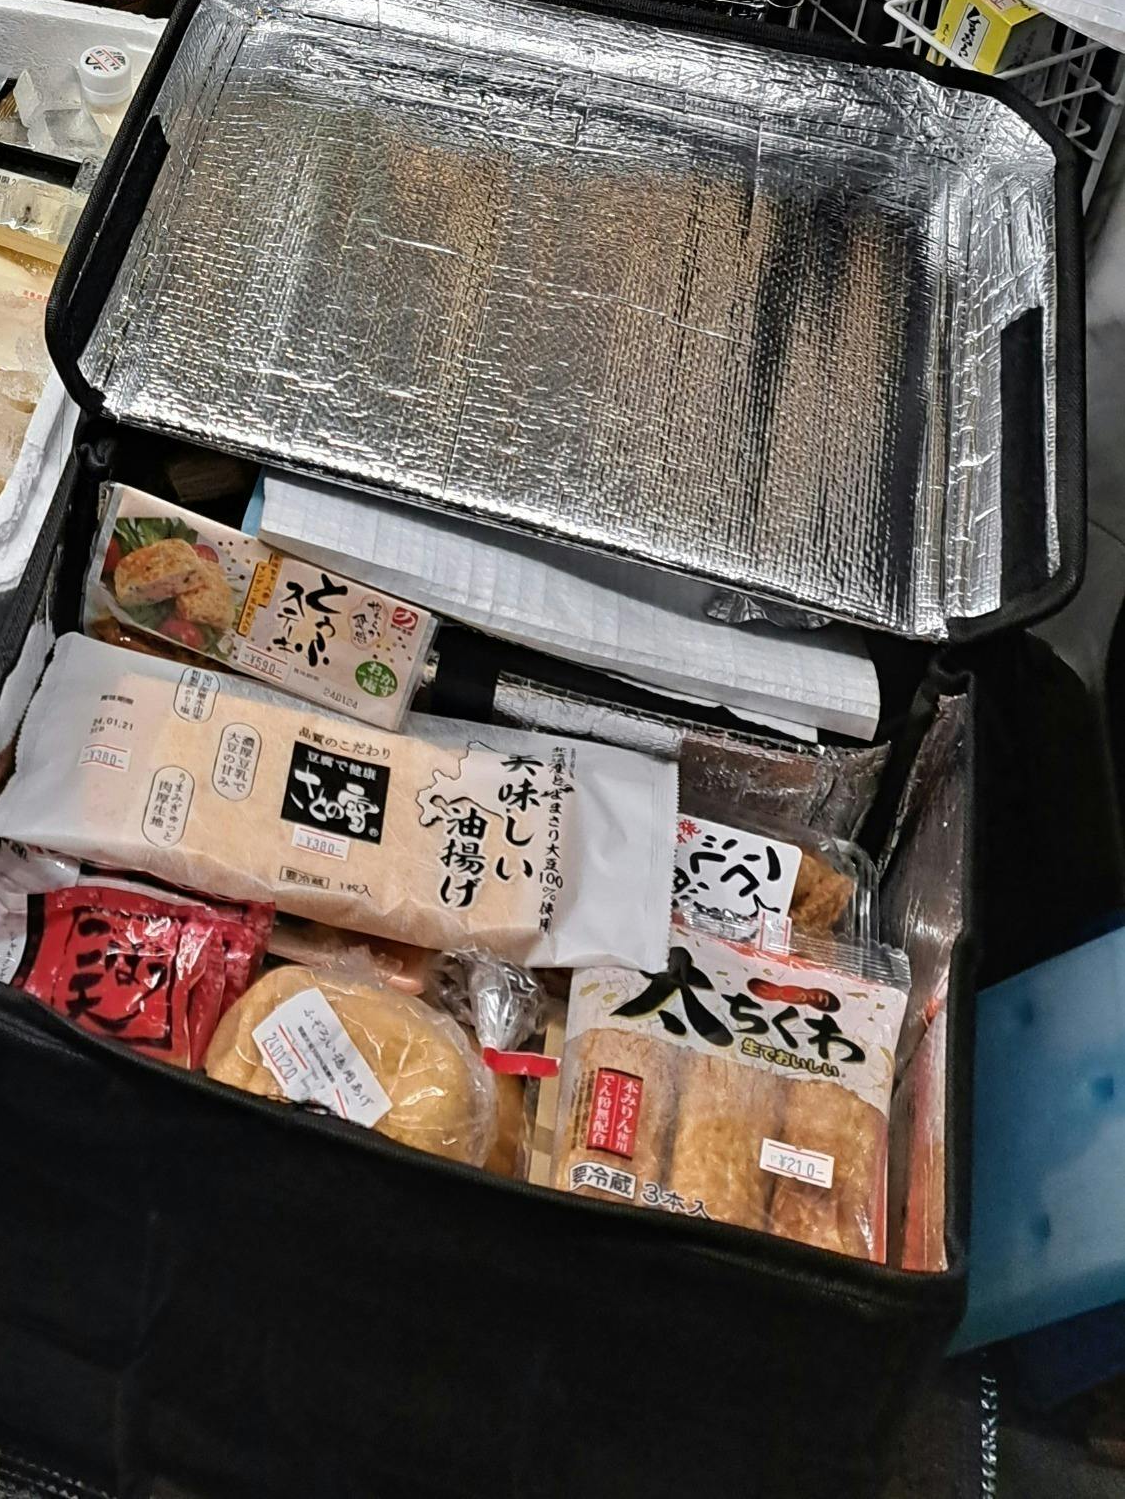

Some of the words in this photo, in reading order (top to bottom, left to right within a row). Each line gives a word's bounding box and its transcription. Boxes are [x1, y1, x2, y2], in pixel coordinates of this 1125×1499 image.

[217, 731, 242, 789] 大豆の甘み
[233, 735, 256, 794] 濃厚豆乳で
[299, 726, 392, 760] 品質のこだわり
[307, 750, 378, 781] 豆腐で健康
[149, 780, 173, 829] 肉厚生地
[162, 772, 187, 842] うまみぎゅっと
[290, 763, 380, 834] さとの雪
[285, 870, 325, 888] 要冷蔵
[439, 806, 489, 908] 油揚げ
[339, 881, 373, 898] 1枚入
[608, 946, 867, 1063] 太ちくわ
[741, 1037, 839, 1078] 生でおいしい
[619, 1078, 640, 1153] 本みりん使用
[571, 1165, 633, 1196] 要冷蔵
[641, 1182, 711, 1220] 3本入
